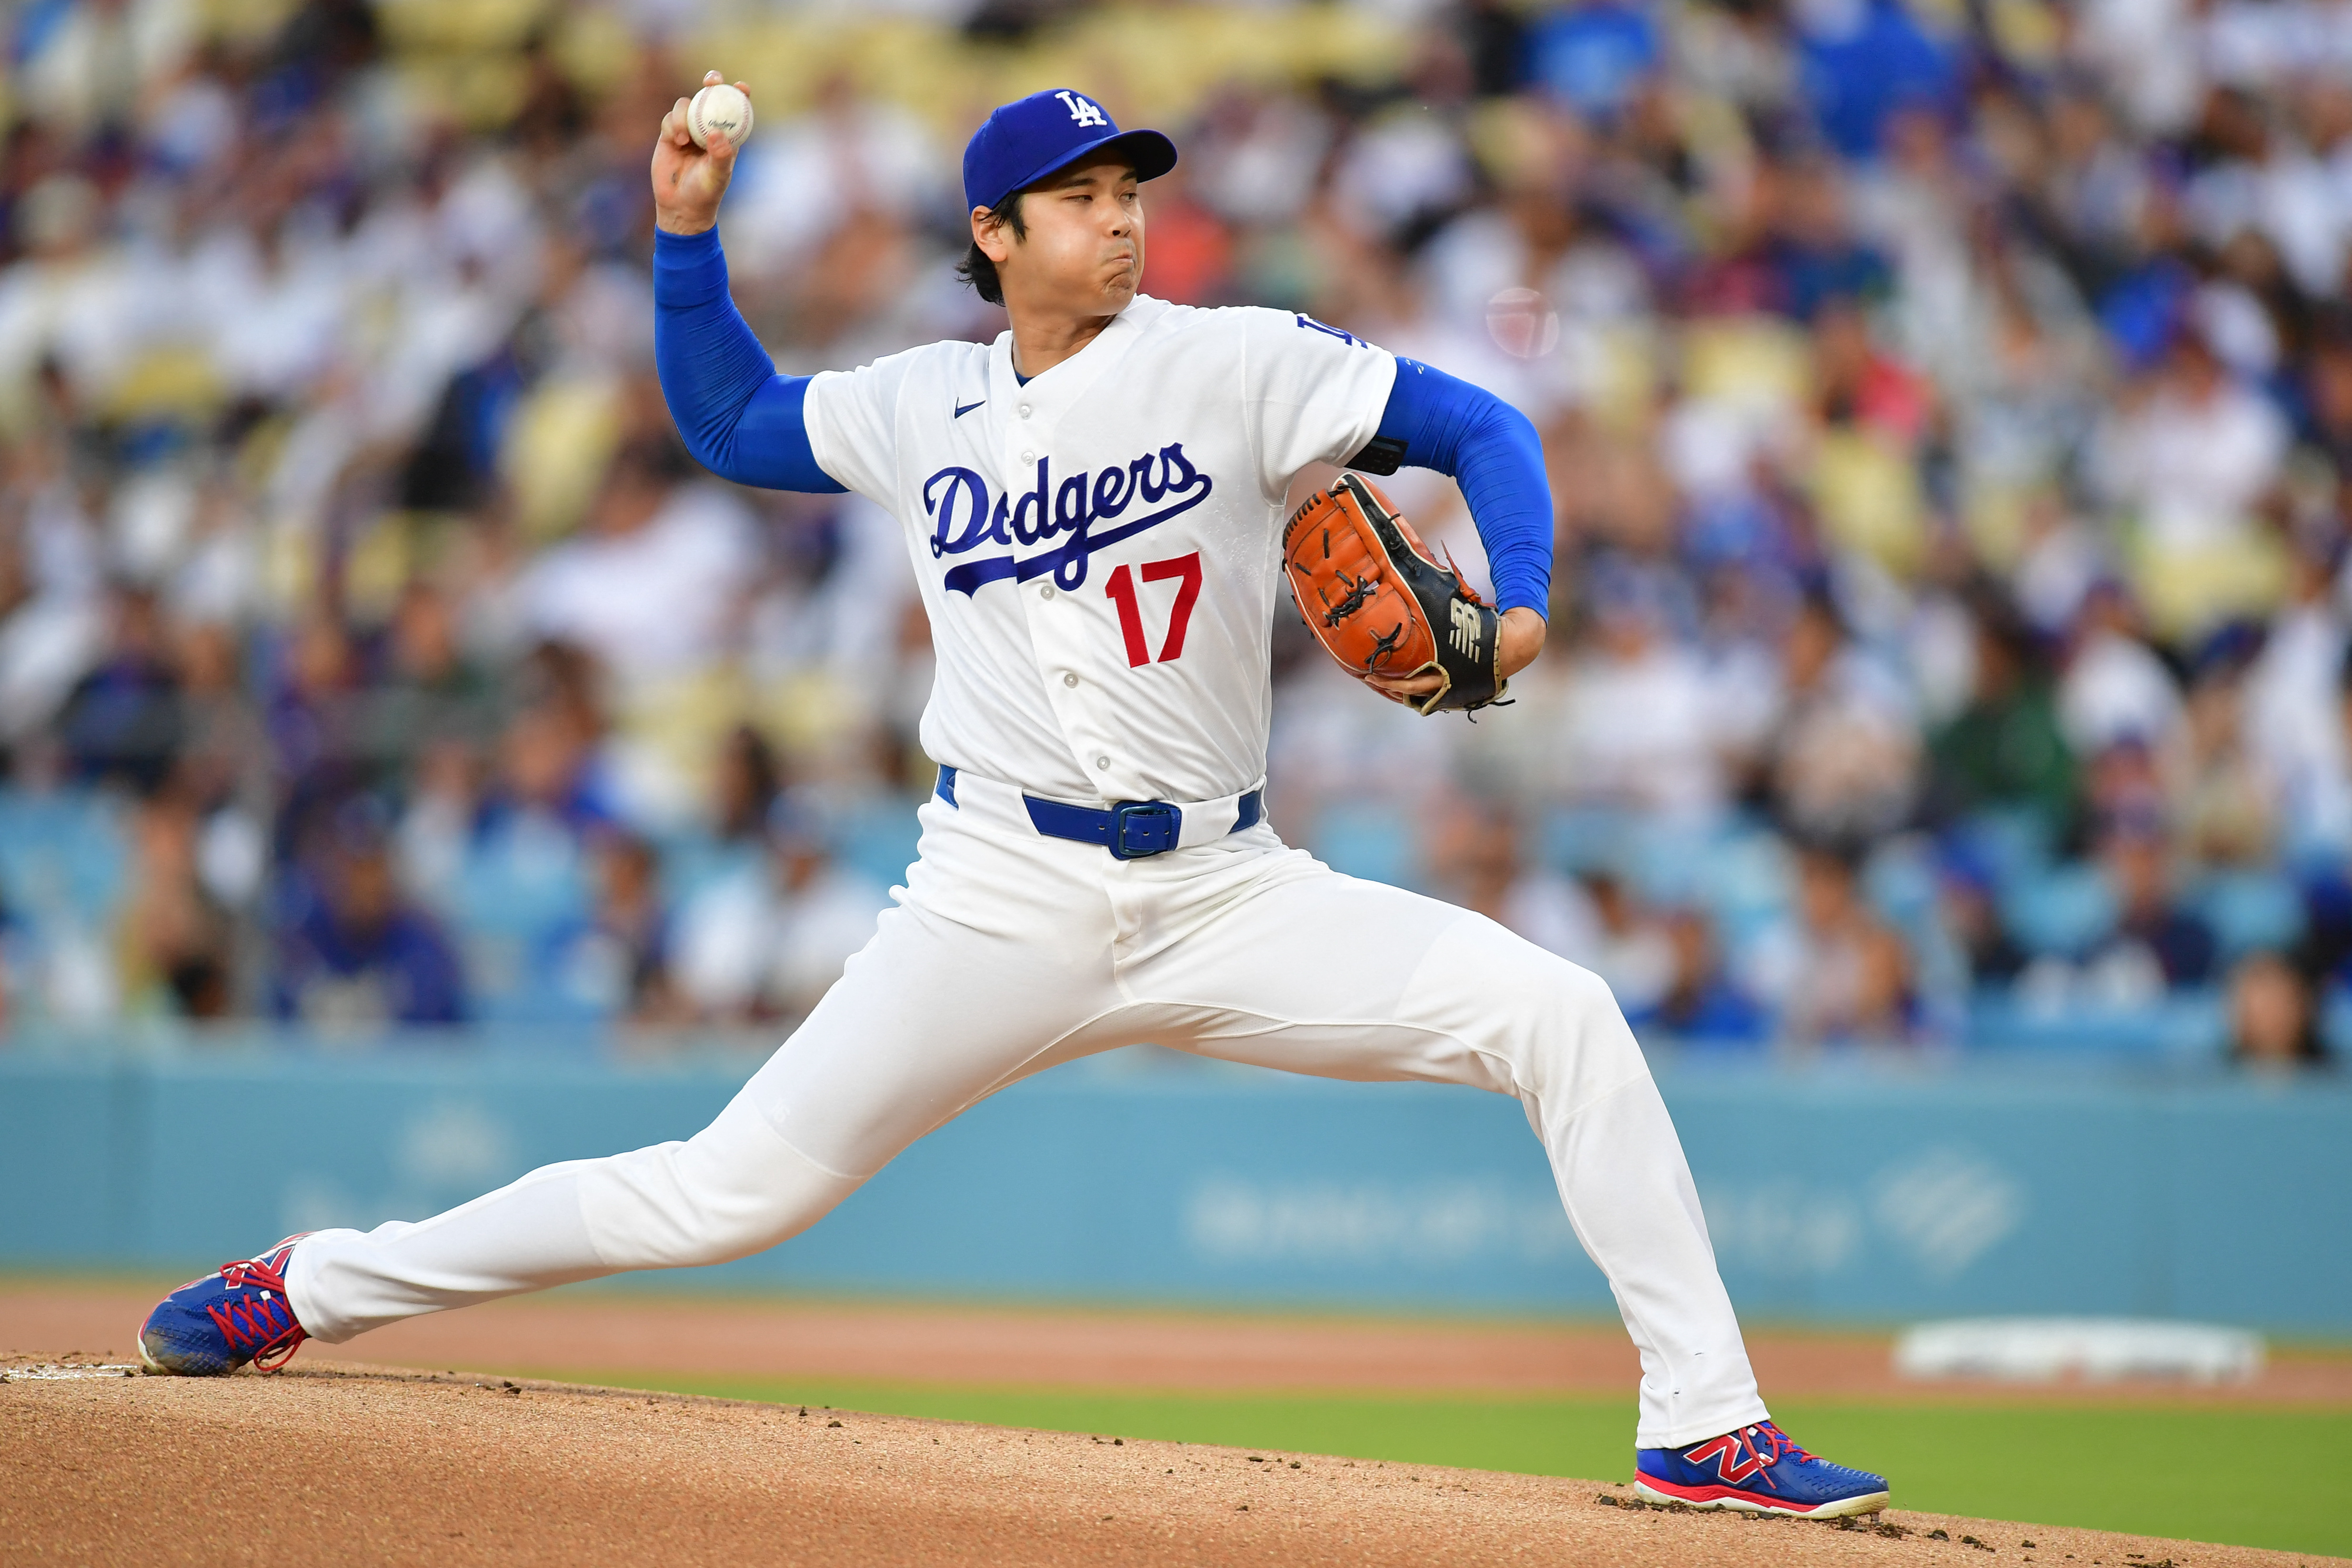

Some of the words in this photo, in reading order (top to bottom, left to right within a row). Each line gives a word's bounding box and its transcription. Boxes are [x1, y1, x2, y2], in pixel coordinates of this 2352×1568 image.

[1055, 90, 1107, 128] LA
[923, 442, 1212, 600] Dodgers
[1105, 551, 1203, 669] 17
